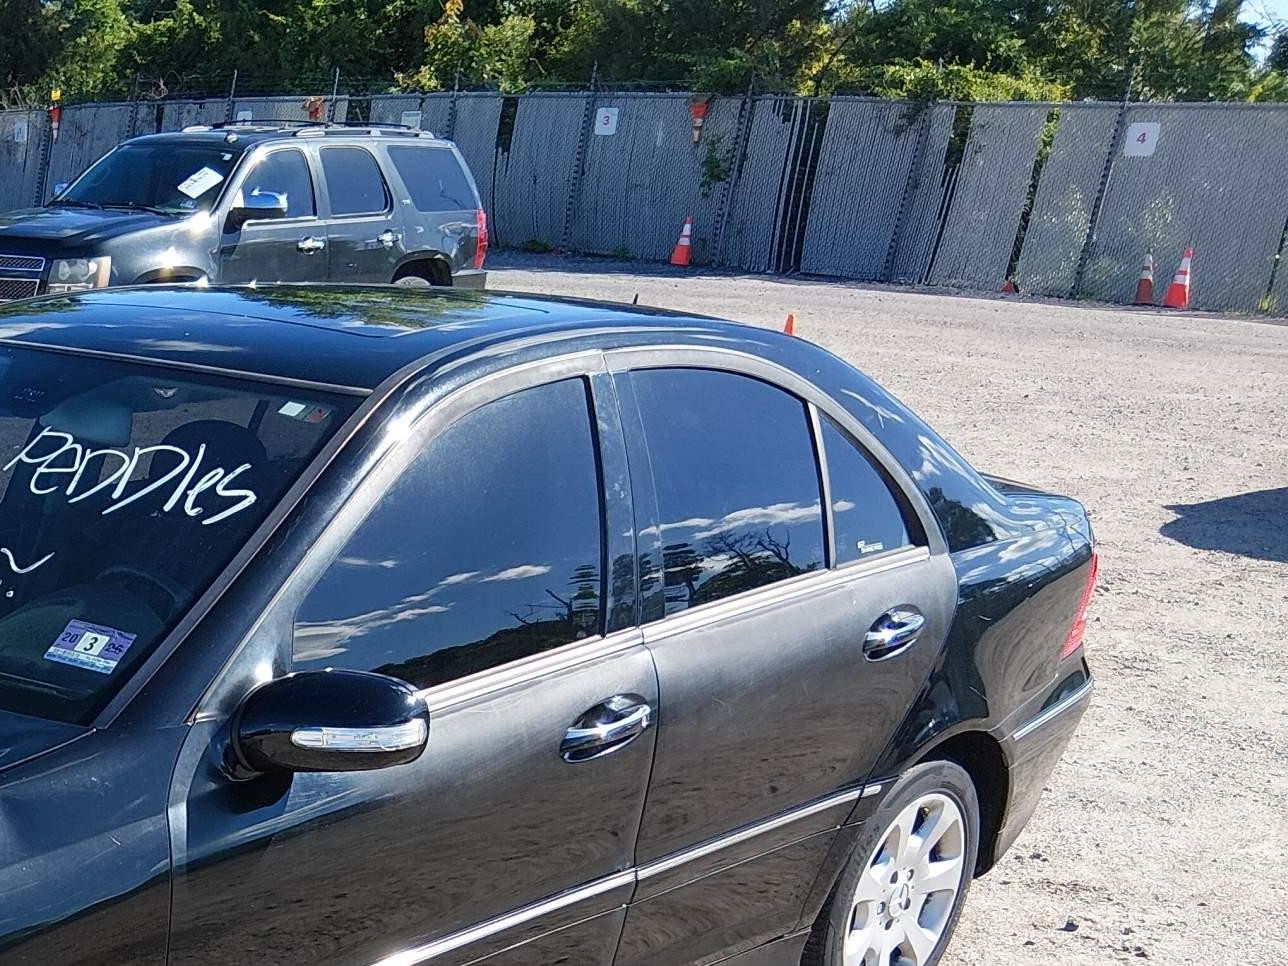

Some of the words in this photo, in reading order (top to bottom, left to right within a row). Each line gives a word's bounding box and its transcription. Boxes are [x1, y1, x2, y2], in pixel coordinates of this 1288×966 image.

[602, 115, 610, 126] 3
[1136, 131, 1147, 144] 4
[62, 632, 79, 644] 20
[83, 636, 99, 652] 3
